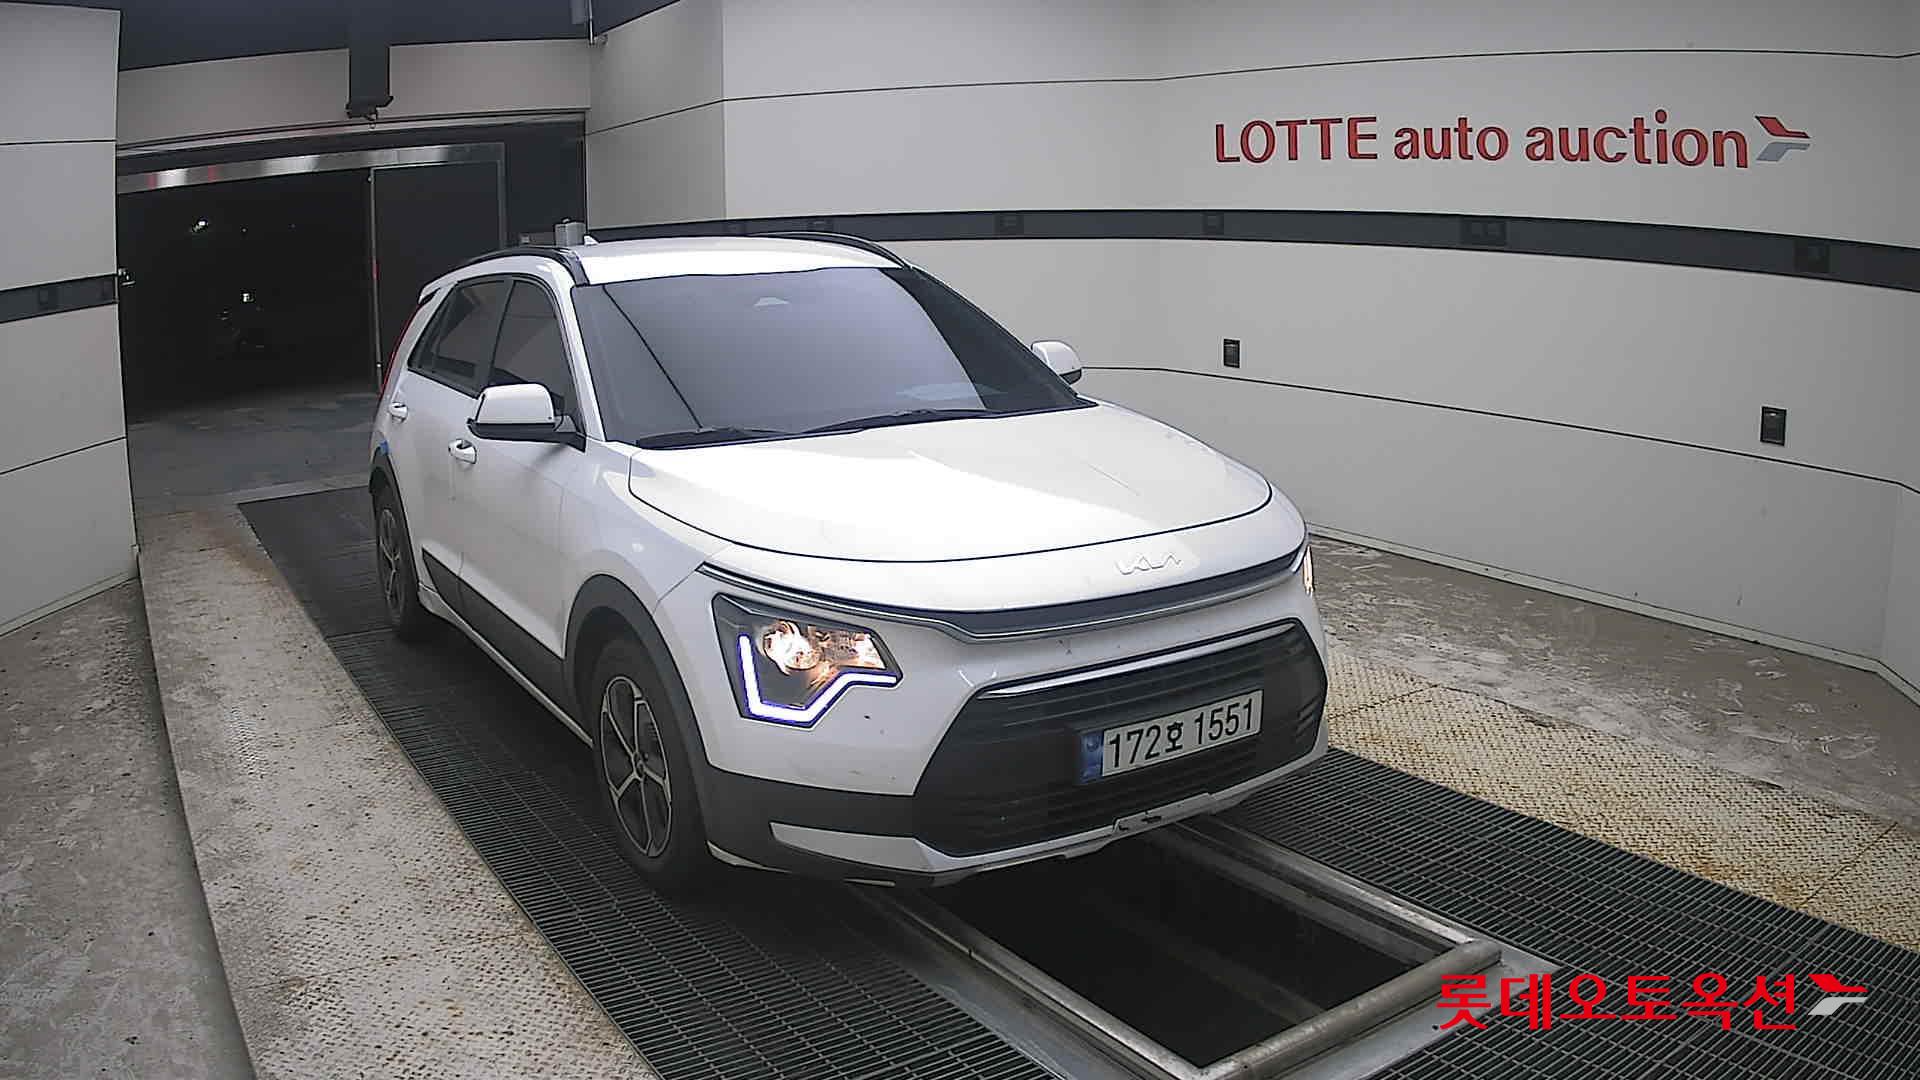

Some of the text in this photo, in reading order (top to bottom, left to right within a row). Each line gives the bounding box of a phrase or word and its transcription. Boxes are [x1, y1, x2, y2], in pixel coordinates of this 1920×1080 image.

[1214, 109, 1749, 168] LOTTE auto auction
[1109, 698, 1253, 769] 172호 1551
